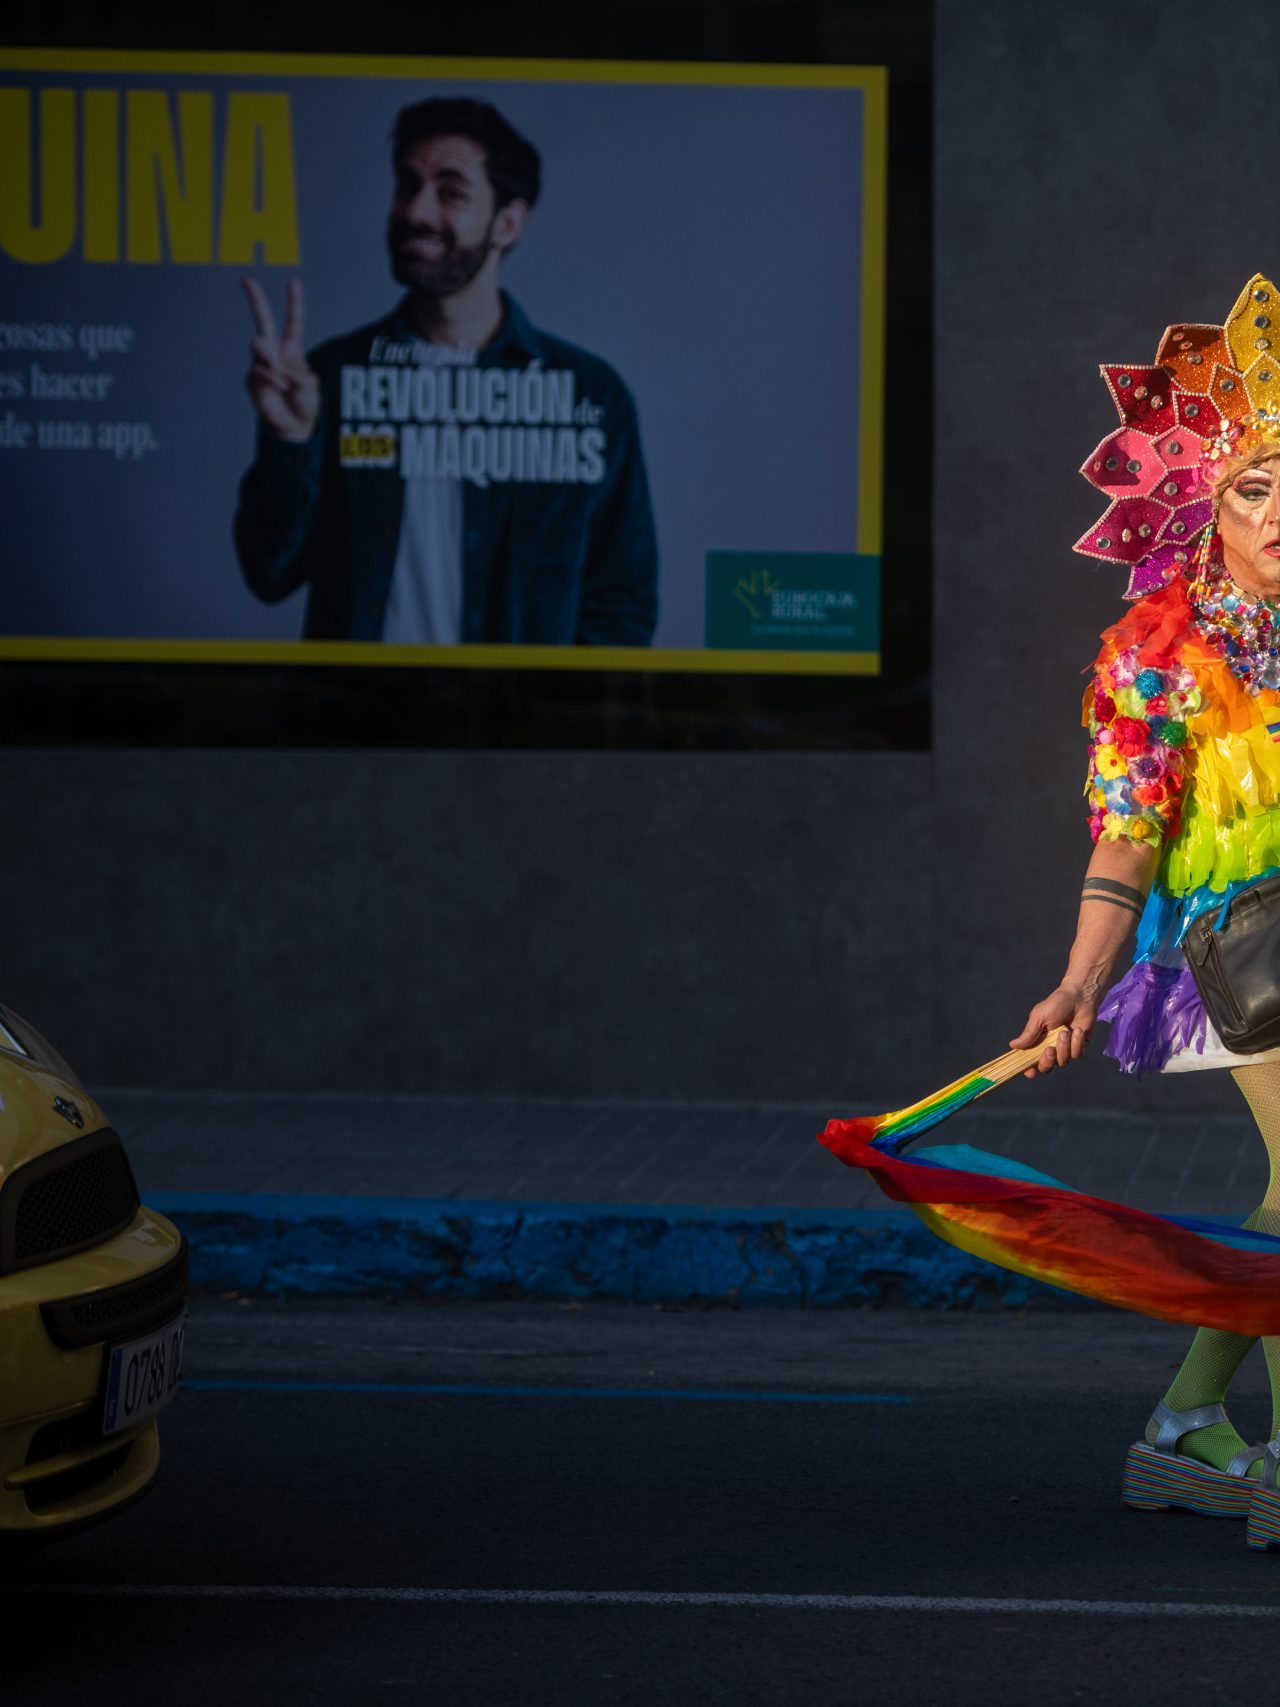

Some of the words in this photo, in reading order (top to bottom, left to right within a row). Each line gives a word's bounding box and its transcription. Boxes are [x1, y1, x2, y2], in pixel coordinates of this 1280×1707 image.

[0, 87, 299, 265] UINA
[78, 322, 135, 361] que
[30, 361, 116, 400] hacer
[341, 358, 576, 425] REVOLUCIÓN
[575, 397, 605, 426] de
[37, 421, 93, 449] una
[97, 421, 160, 460] app.
[400, 409, 607, 489] MÁQUINAS
[124, 1338, 165, 1416] 0788
